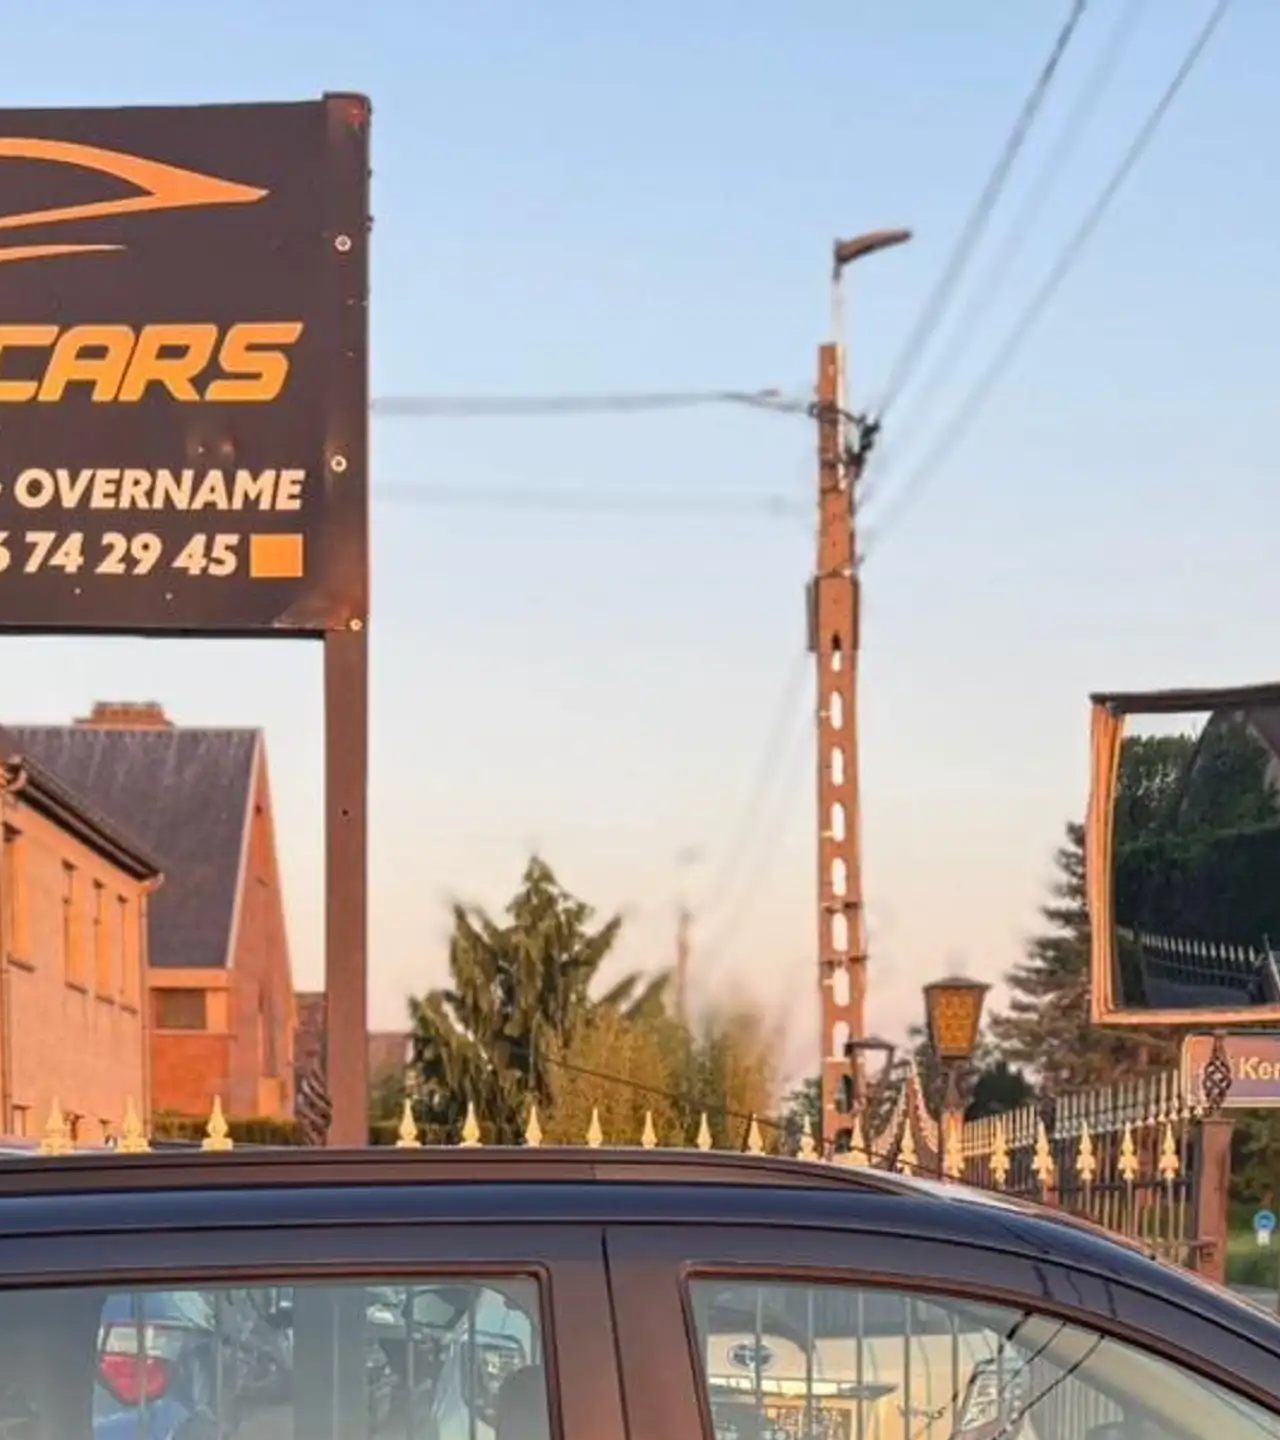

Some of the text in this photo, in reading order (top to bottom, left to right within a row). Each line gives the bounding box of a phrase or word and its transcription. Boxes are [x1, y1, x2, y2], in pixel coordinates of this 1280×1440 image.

[13, 467, 306, 511] OVERNAME
[24, 531, 85, 574] 74
[94, 531, 163, 575] 29
[171, 533, 240, 577] 45
